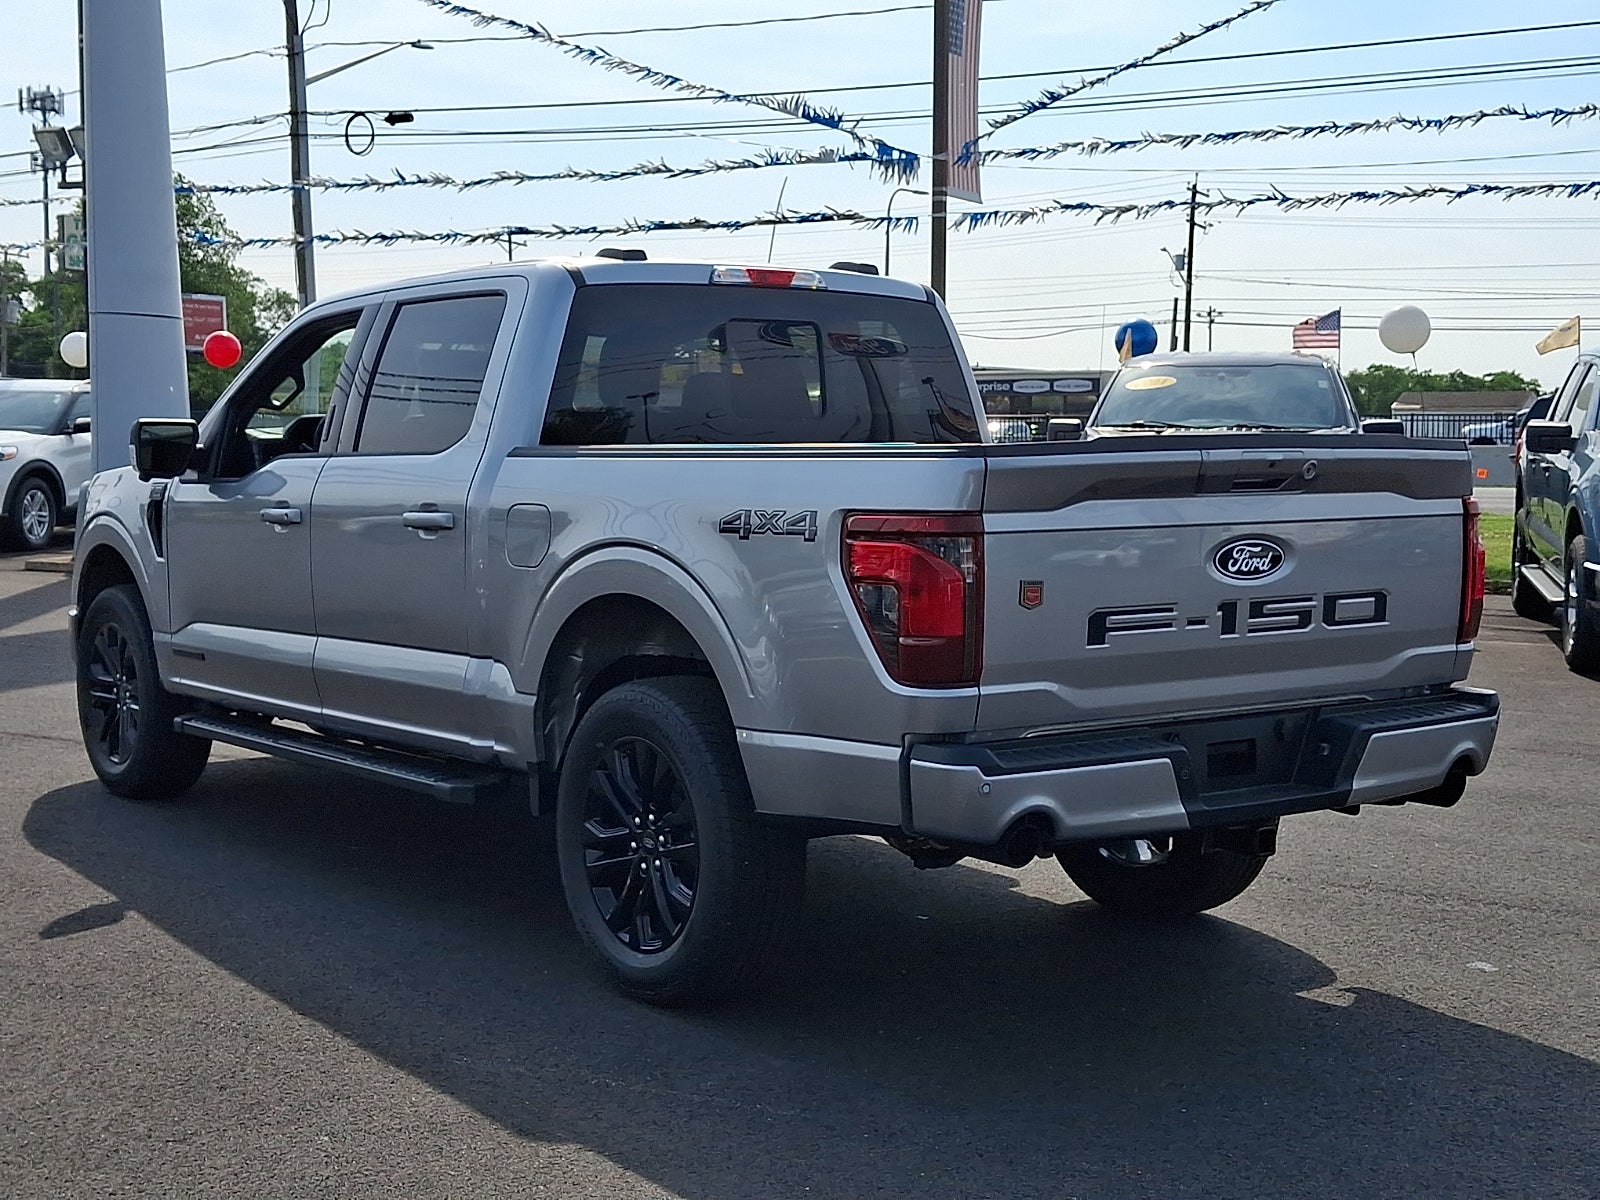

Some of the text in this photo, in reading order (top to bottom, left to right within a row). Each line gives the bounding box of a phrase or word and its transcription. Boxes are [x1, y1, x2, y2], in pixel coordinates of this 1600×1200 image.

[977, 382, 1010, 394] rprise
[1228, 546, 1273, 572] Ford
[1086, 589, 1391, 648] F-150
